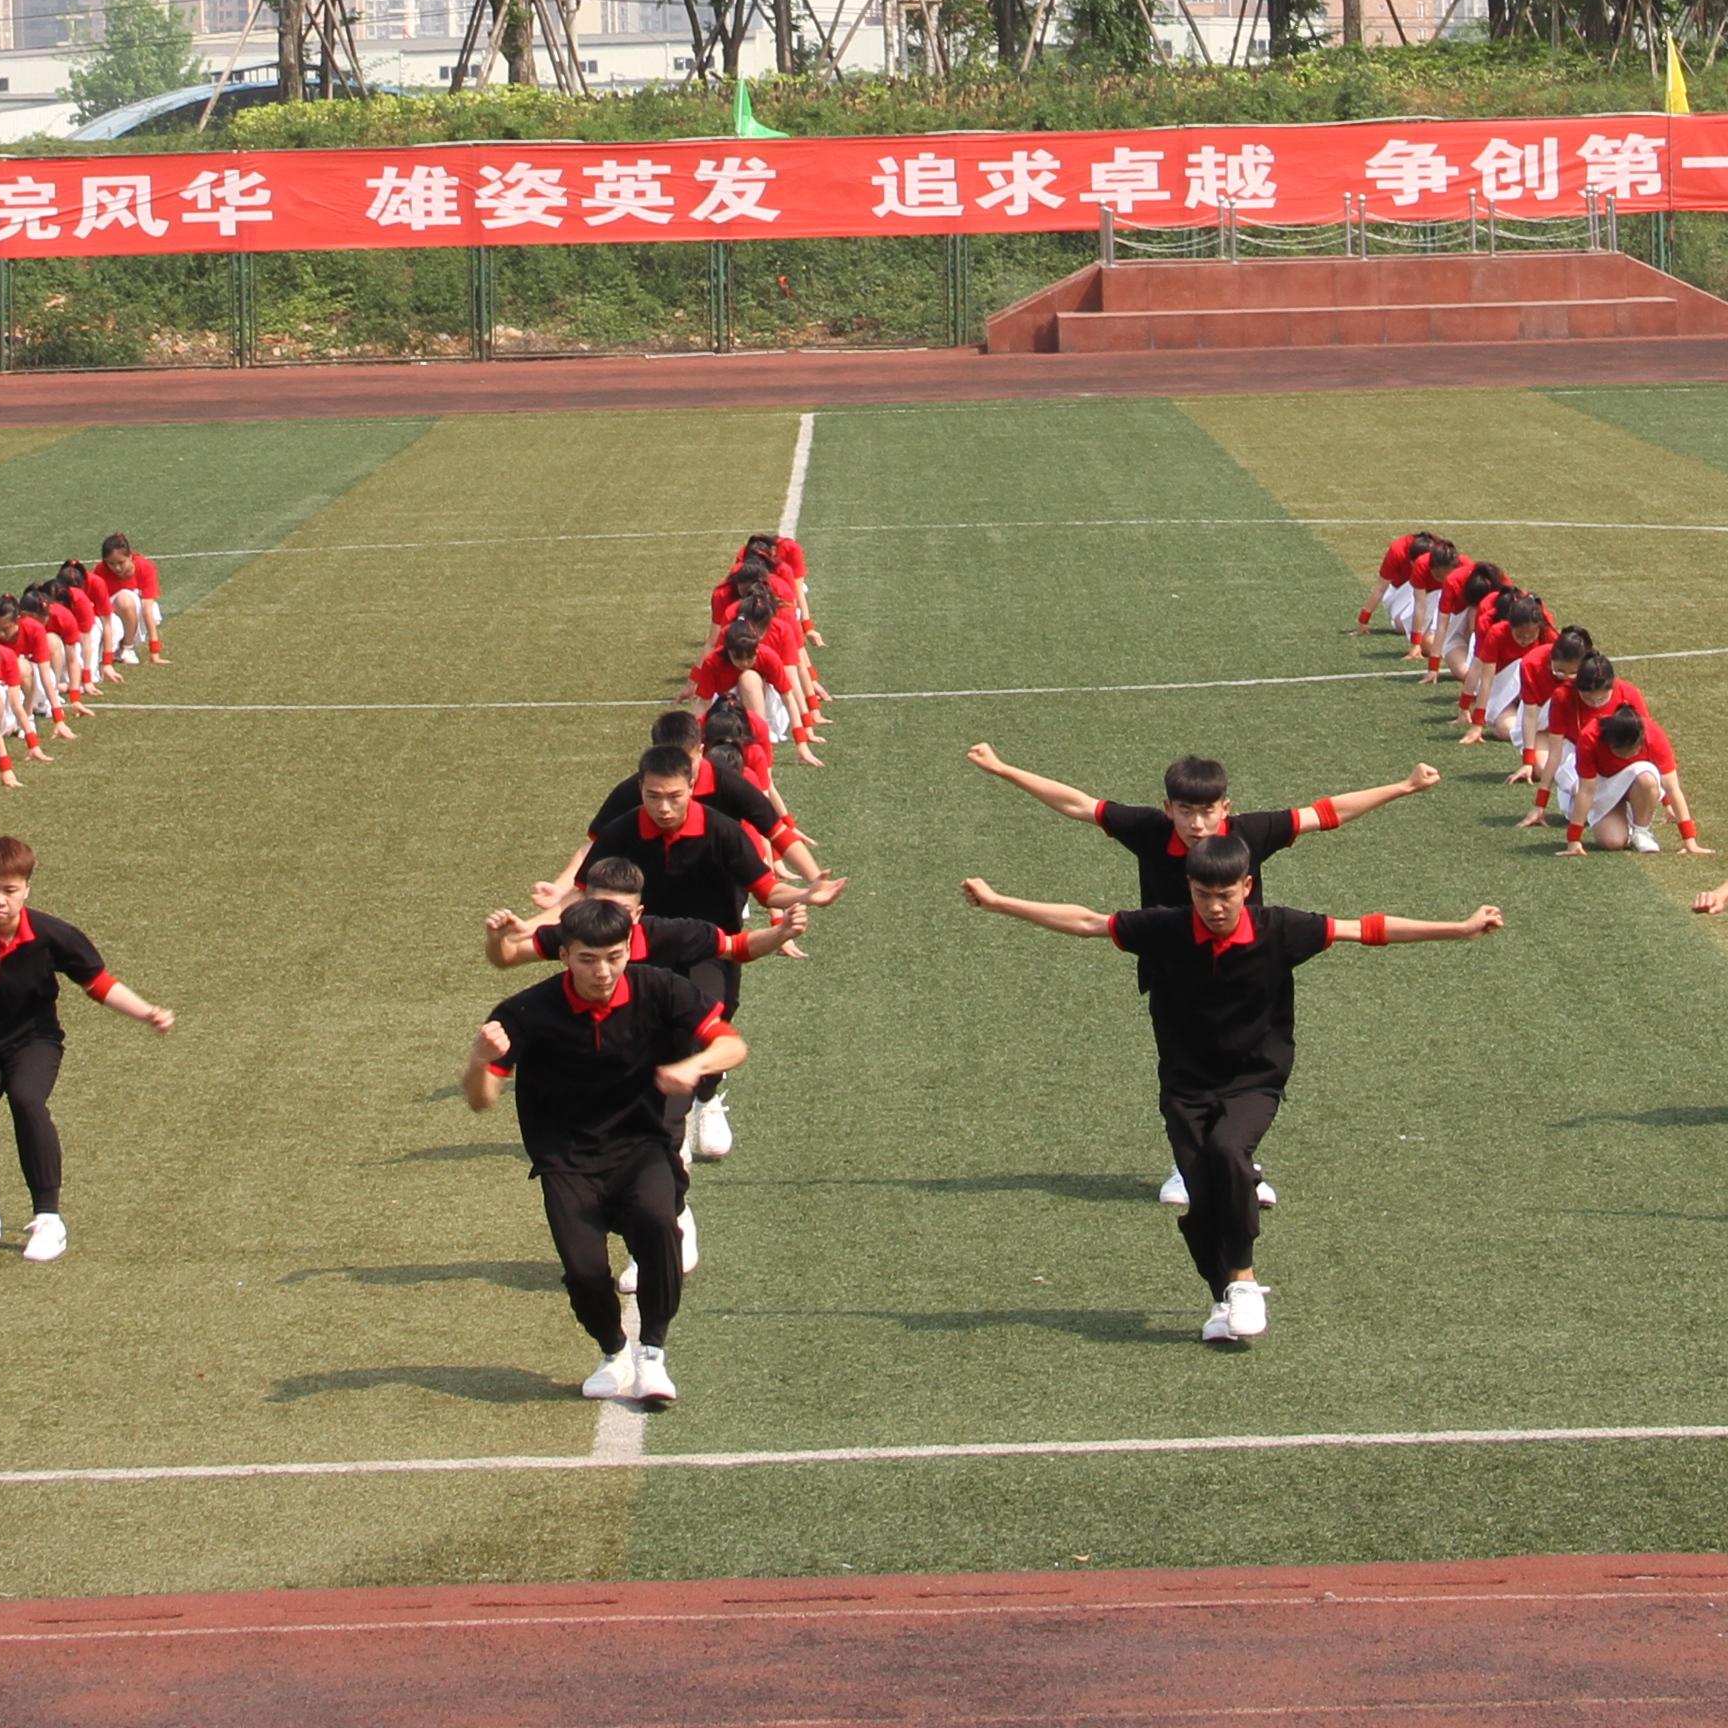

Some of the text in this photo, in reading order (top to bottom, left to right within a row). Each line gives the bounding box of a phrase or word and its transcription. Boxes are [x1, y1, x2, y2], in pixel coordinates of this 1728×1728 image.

[365, 157, 780, 229] 雄姿英发
[871, 143, 1278, 218] 追求卓越
